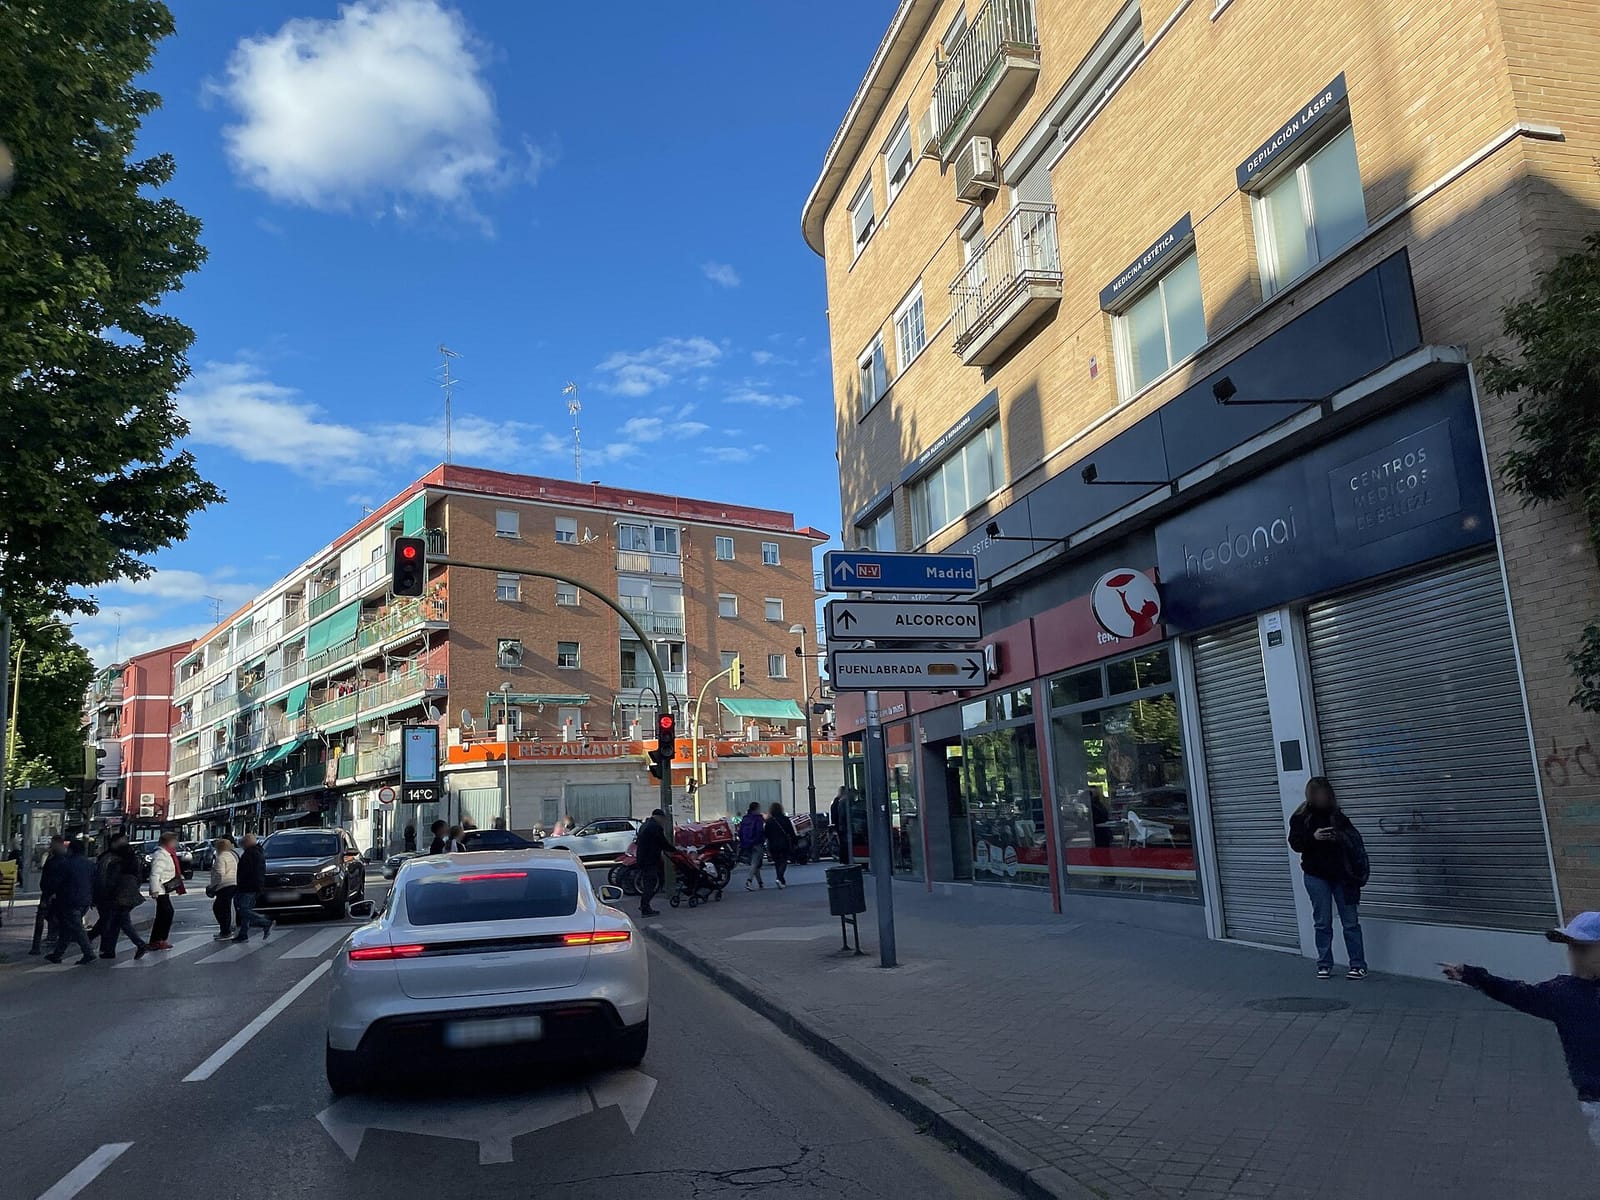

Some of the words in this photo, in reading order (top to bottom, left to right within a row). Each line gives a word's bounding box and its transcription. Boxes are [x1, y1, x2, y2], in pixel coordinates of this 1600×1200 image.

[1247, 121, 1299, 173] DEPILACIÓN
[1301, 91, 1333, 125] LÁSER
[1112, 262, 1142, 292] MEDICINA
[1143, 234, 1174, 265] ESTÉTICA
[1350, 448, 1427, 491] CENTROS
[1182, 504, 1297, 579] hedonai
[858, 565, 879, 577] N-V
[926, 567, 973, 579] Madrid
[895, 614, 976, 627] ALCORCON
[839, 665, 922, 675] FUENLABRADA
[519, 743, 631, 757] RESTAURANTE
[408, 789, 433, 801] 14°C
